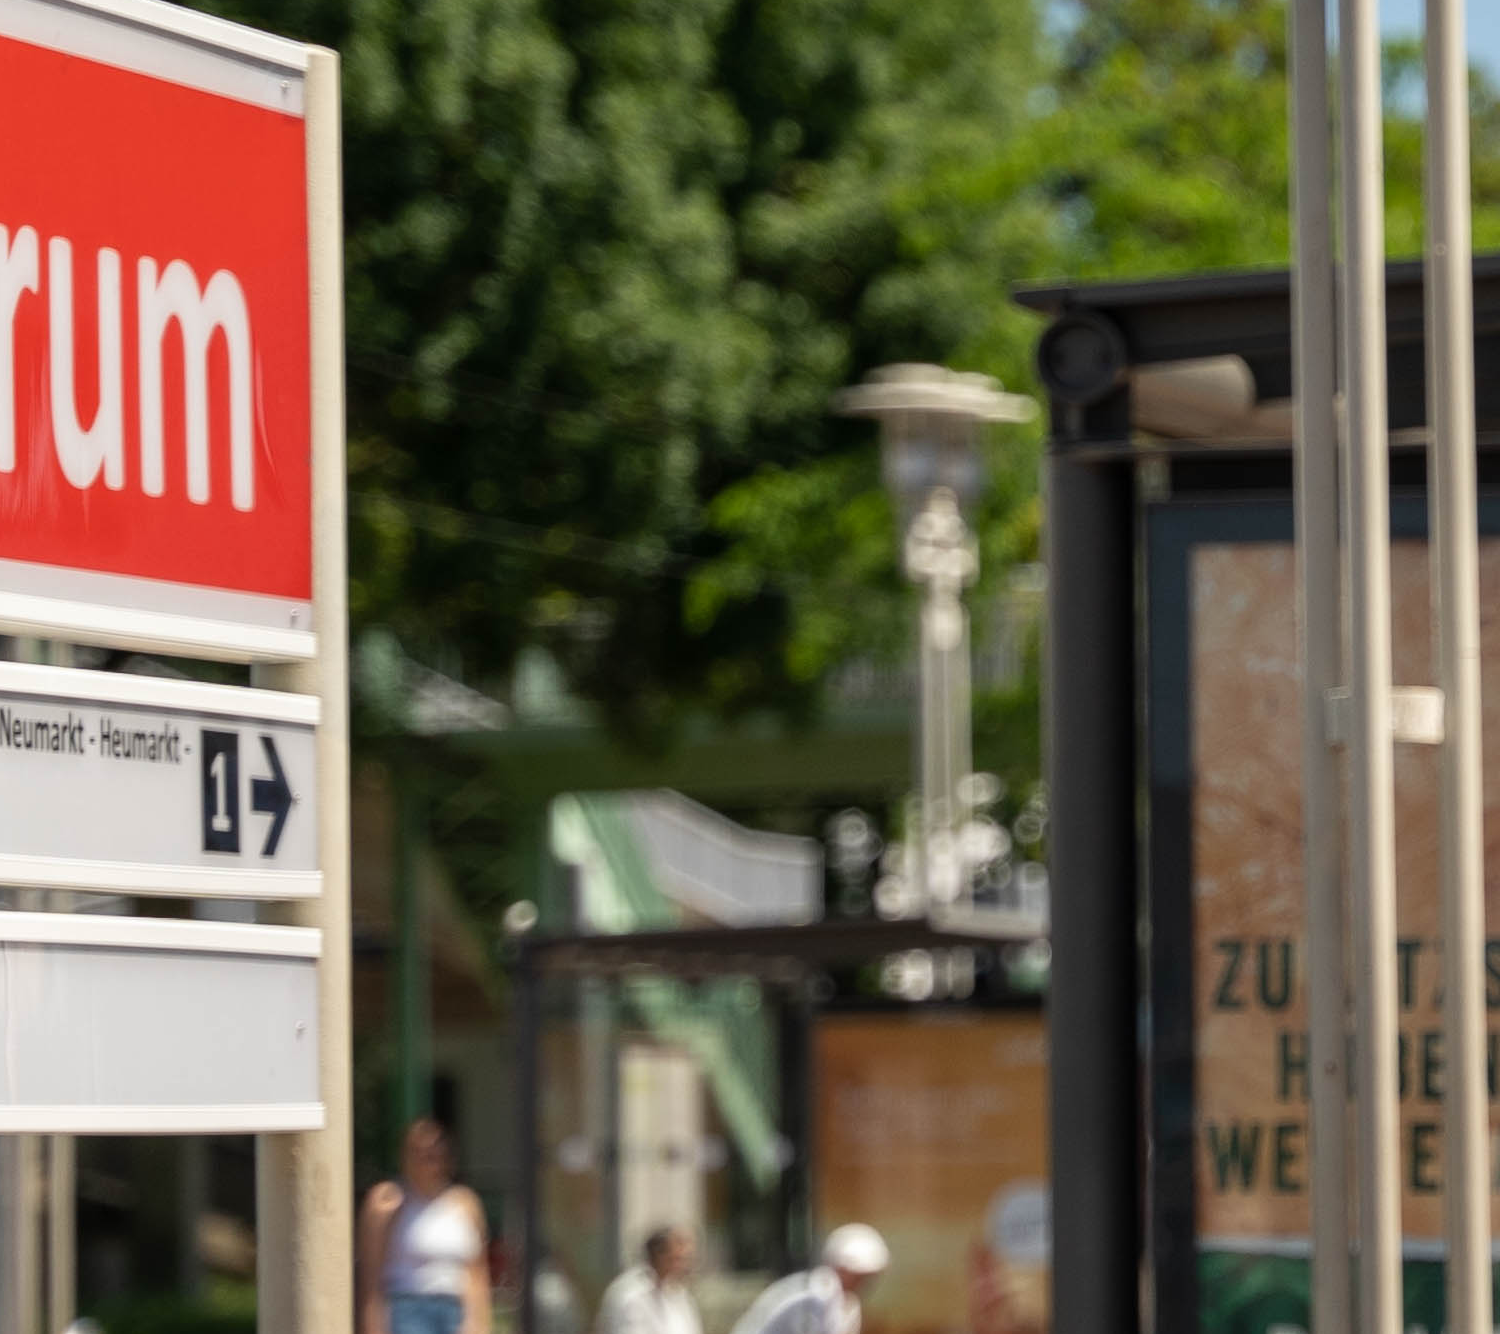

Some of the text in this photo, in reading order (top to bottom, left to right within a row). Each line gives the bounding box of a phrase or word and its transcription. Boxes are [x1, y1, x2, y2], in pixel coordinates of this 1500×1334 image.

[0, 708, 85, 755] Neumarkt
[100, 720, 181, 764] Heumarkt
[209, 752, 233, 834] 1
